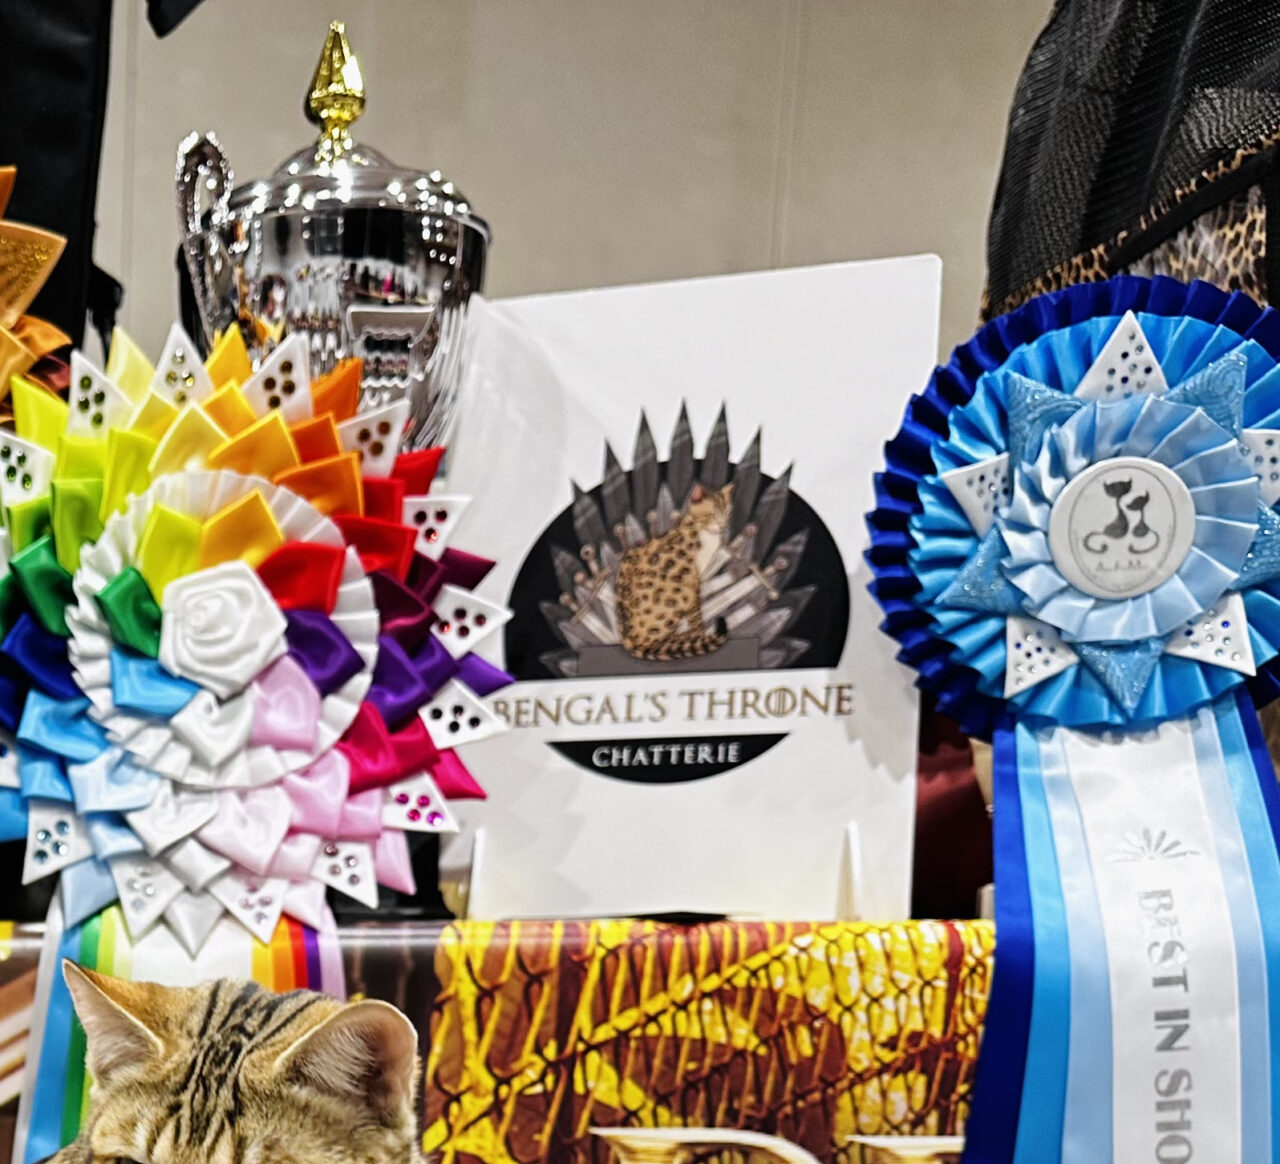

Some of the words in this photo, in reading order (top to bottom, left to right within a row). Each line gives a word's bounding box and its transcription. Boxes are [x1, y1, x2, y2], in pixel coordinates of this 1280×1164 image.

[493, 687, 667, 729] BENGAL'S
[678, 684, 855, 724] THRONE
[592, 741, 741, 768] CHATTERIE
[1136, 889, 1190, 992] BEST
[1153, 1009, 1191, 1052] IN
